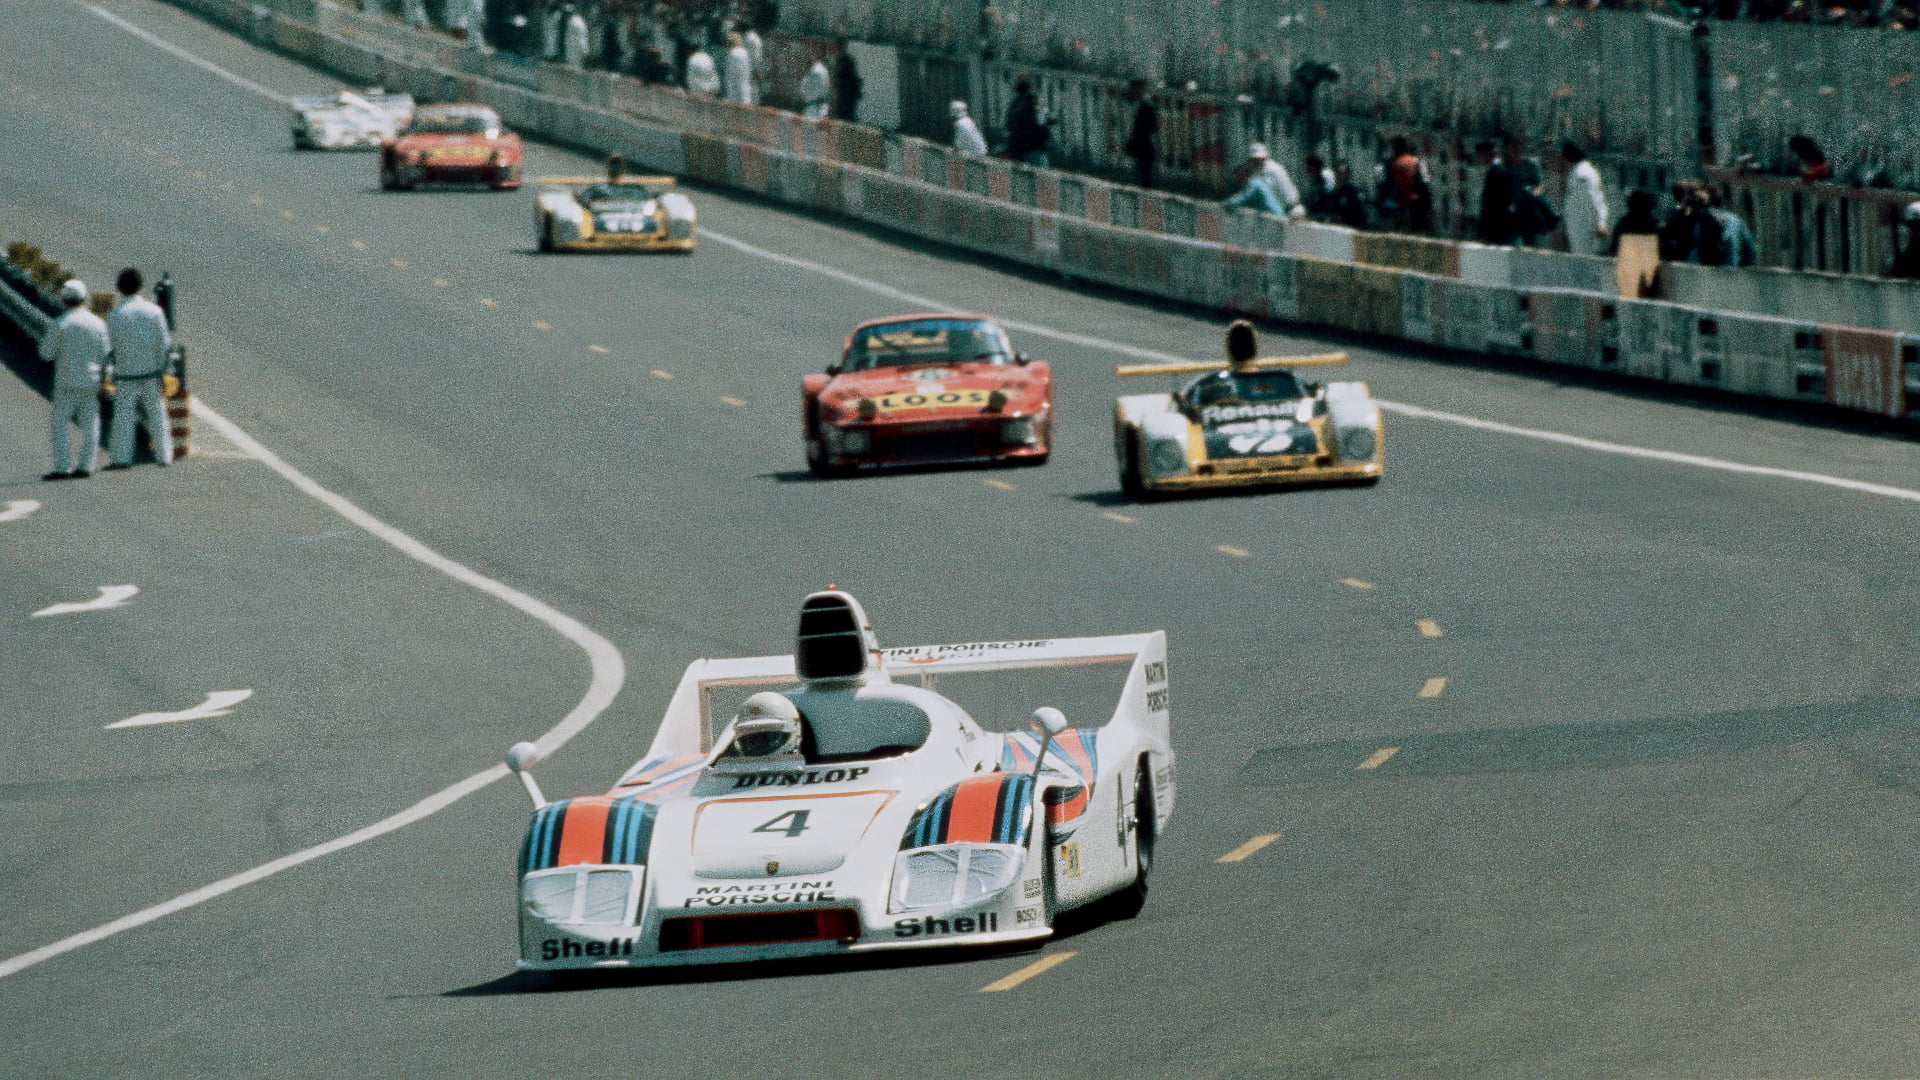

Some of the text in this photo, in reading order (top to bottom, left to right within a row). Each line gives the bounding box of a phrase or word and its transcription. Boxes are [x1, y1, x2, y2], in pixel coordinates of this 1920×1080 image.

[881, 392, 983, 408] LOOS
[938, 640, 1050, 653] PORSCHE
[731, 766, 870, 789] DUNLOP
[750, 808, 812, 838] 4
[696, 880, 834, 895] MARTINI
[684, 890, 836, 908] PORSCHE
[895, 911, 998, 938] Shell
[541, 937, 634, 961] Shell
